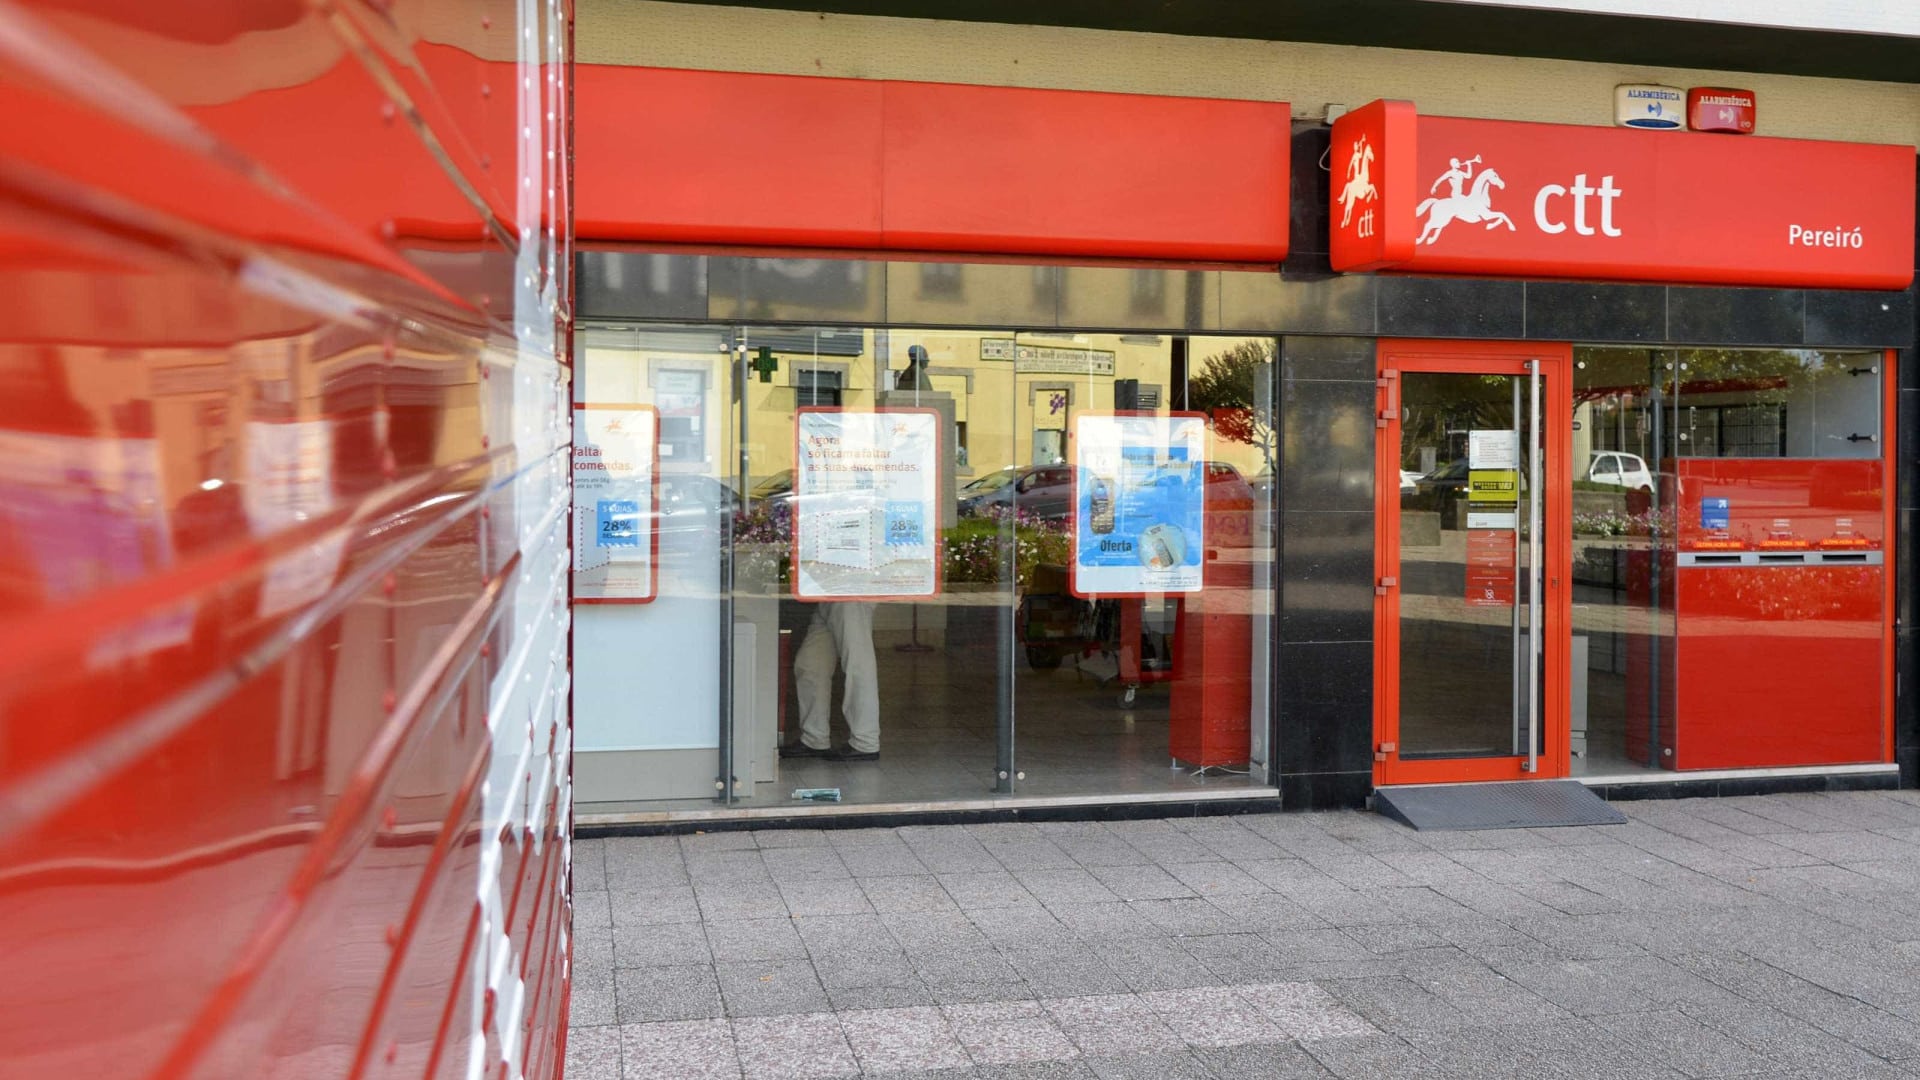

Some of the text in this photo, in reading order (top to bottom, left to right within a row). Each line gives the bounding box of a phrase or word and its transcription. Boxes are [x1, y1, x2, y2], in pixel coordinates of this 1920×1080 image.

[1627, 90, 1680, 101] ALARMIBÉRICA
[1700, 95, 1752, 107] ALARMIBÉRICA
[1534, 174, 1622, 237] ctt
[1358, 209, 1374, 238] ctt
[1788, 224, 1863, 248] Pereiró
[808, 435, 840, 447] Agora
[808, 464, 820, 472] as
[823, 464, 847, 472] suas
[602, 520, 632, 532] 28%
[890, 519, 918, 531] 28%
[1100, 540, 1132, 552] Oferta
